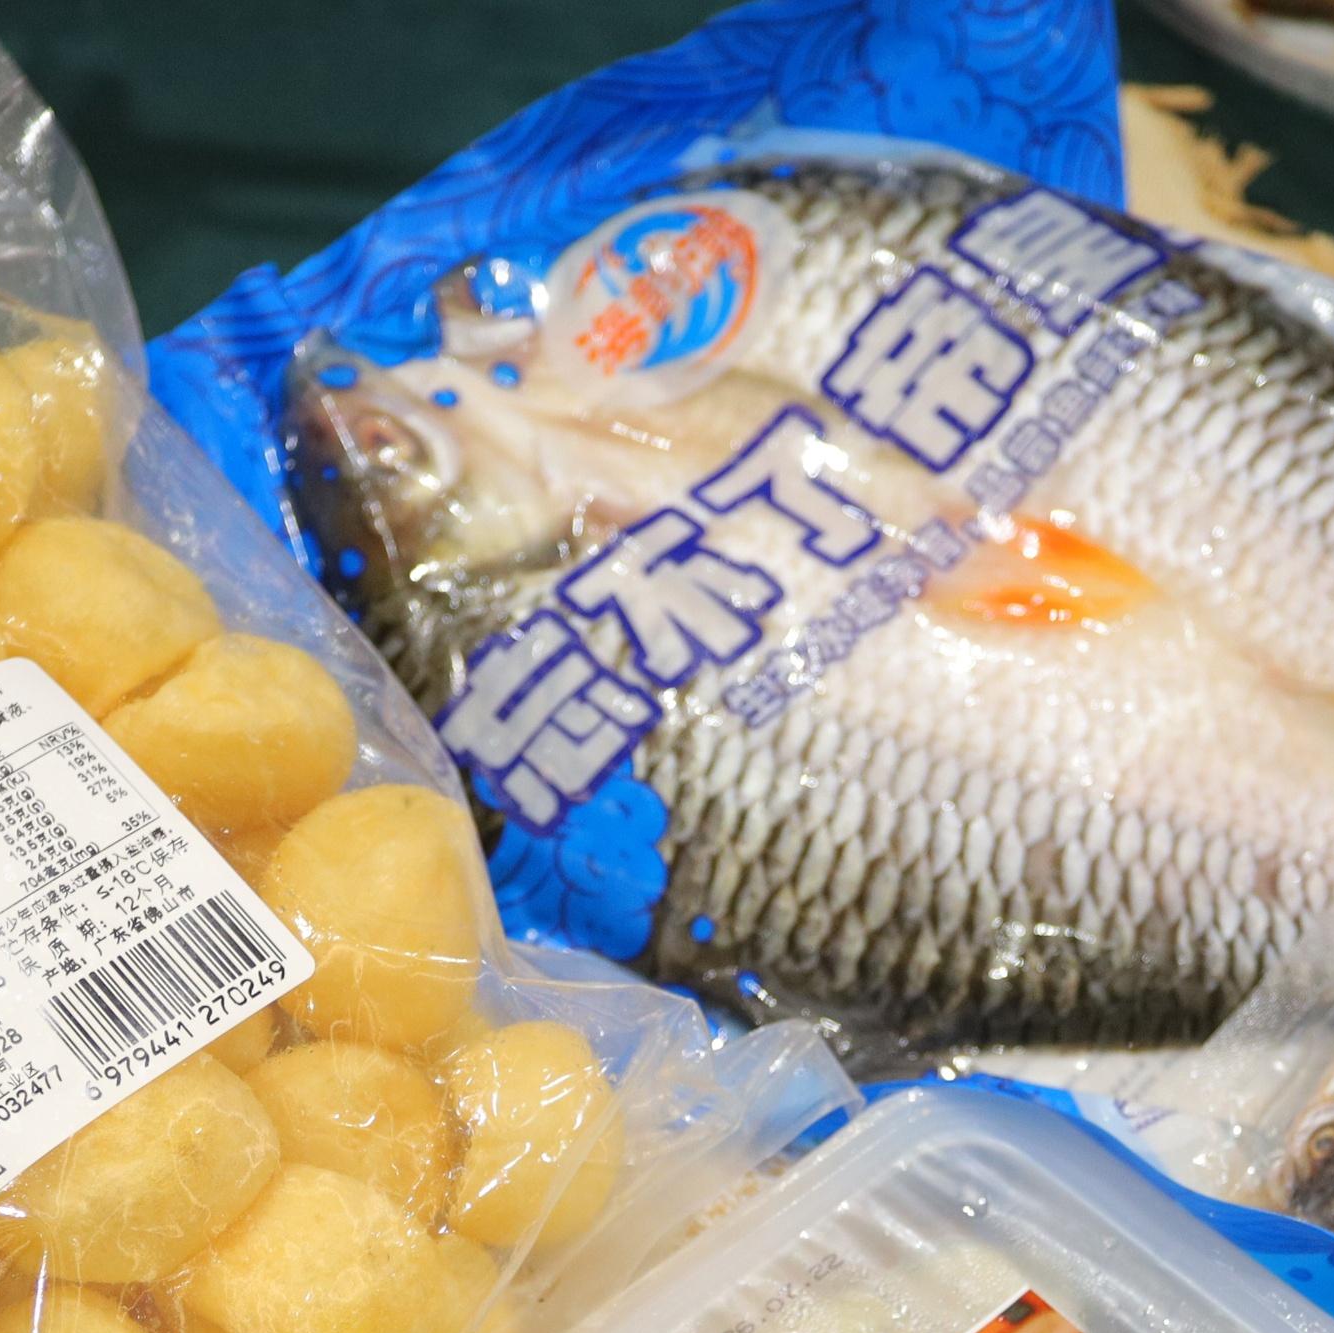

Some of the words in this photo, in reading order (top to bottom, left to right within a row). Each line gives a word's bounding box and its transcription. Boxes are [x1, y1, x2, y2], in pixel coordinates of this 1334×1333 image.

[435, 186, 1169, 838] 忘不了帝皇
[55, 739, 86, 759] 13%
[77, 761, 108, 783] 31%
[85, 773, 117, 796] 27%
[101, 1019, 194, 1087] 979441
[196, 958, 291, 1026] 270249
